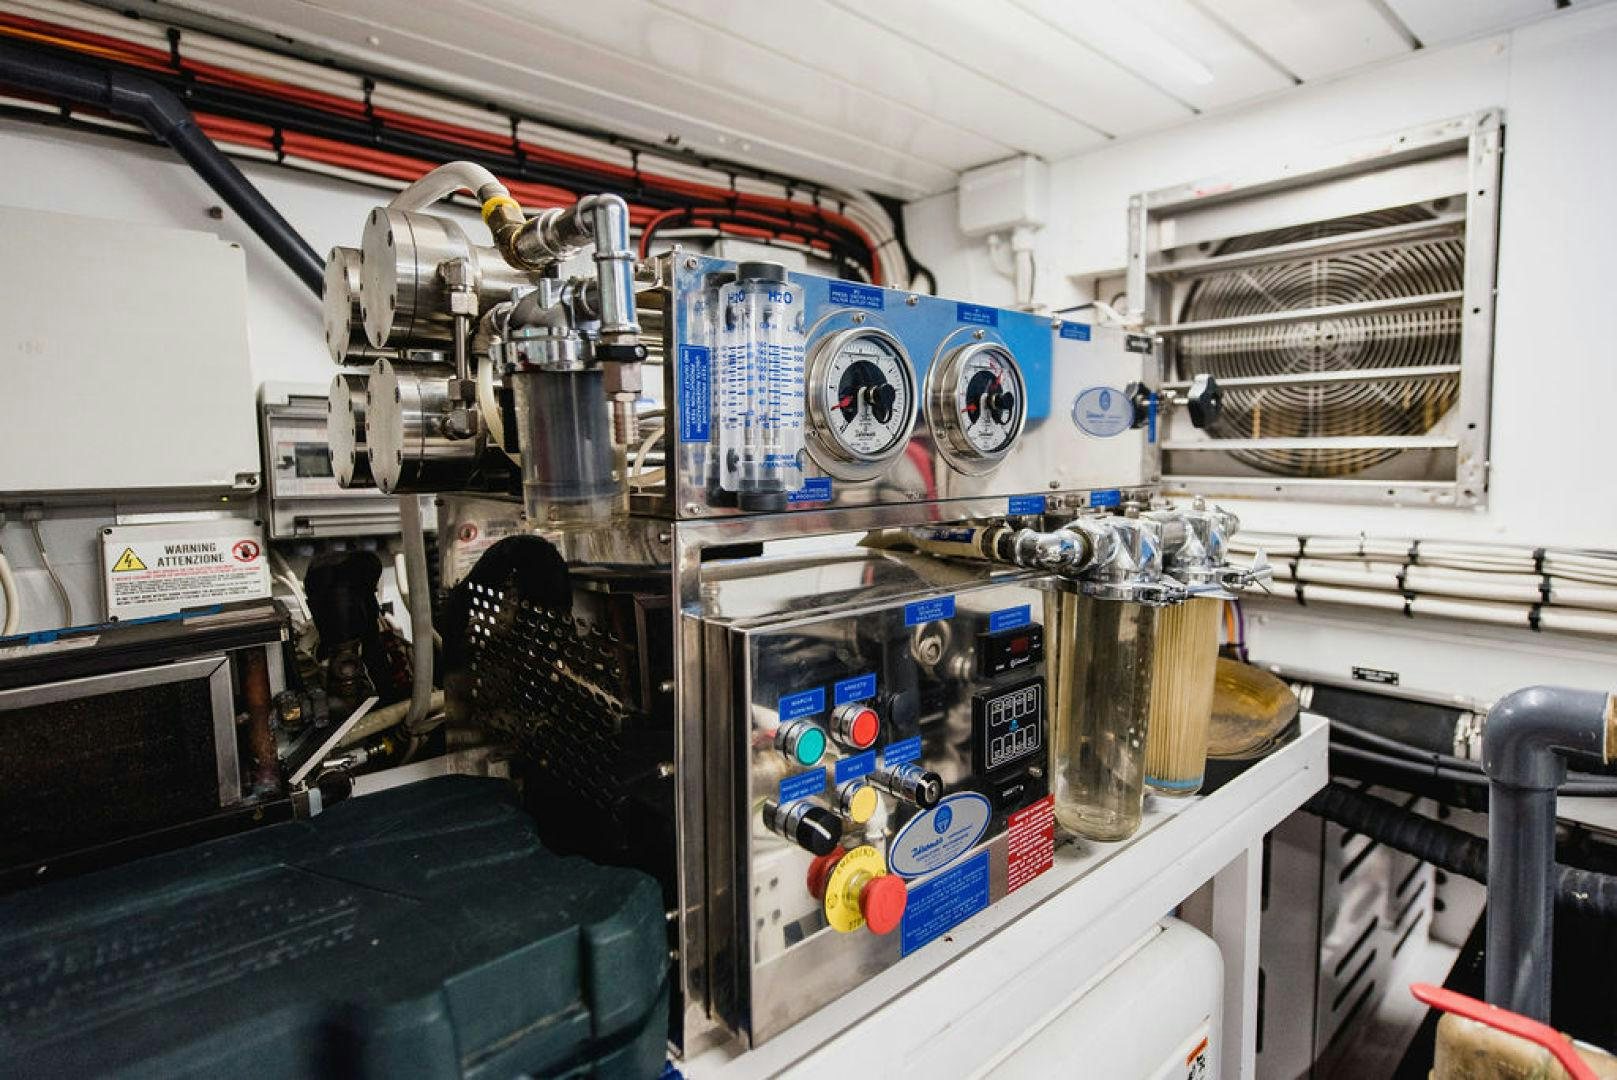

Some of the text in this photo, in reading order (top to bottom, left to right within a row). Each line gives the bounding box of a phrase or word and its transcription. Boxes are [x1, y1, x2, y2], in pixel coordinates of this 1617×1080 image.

[768, 291, 793, 304] H2O
[164, 542, 217, 555] WARNING
[157, 553, 225, 567] ATTENZIONE
